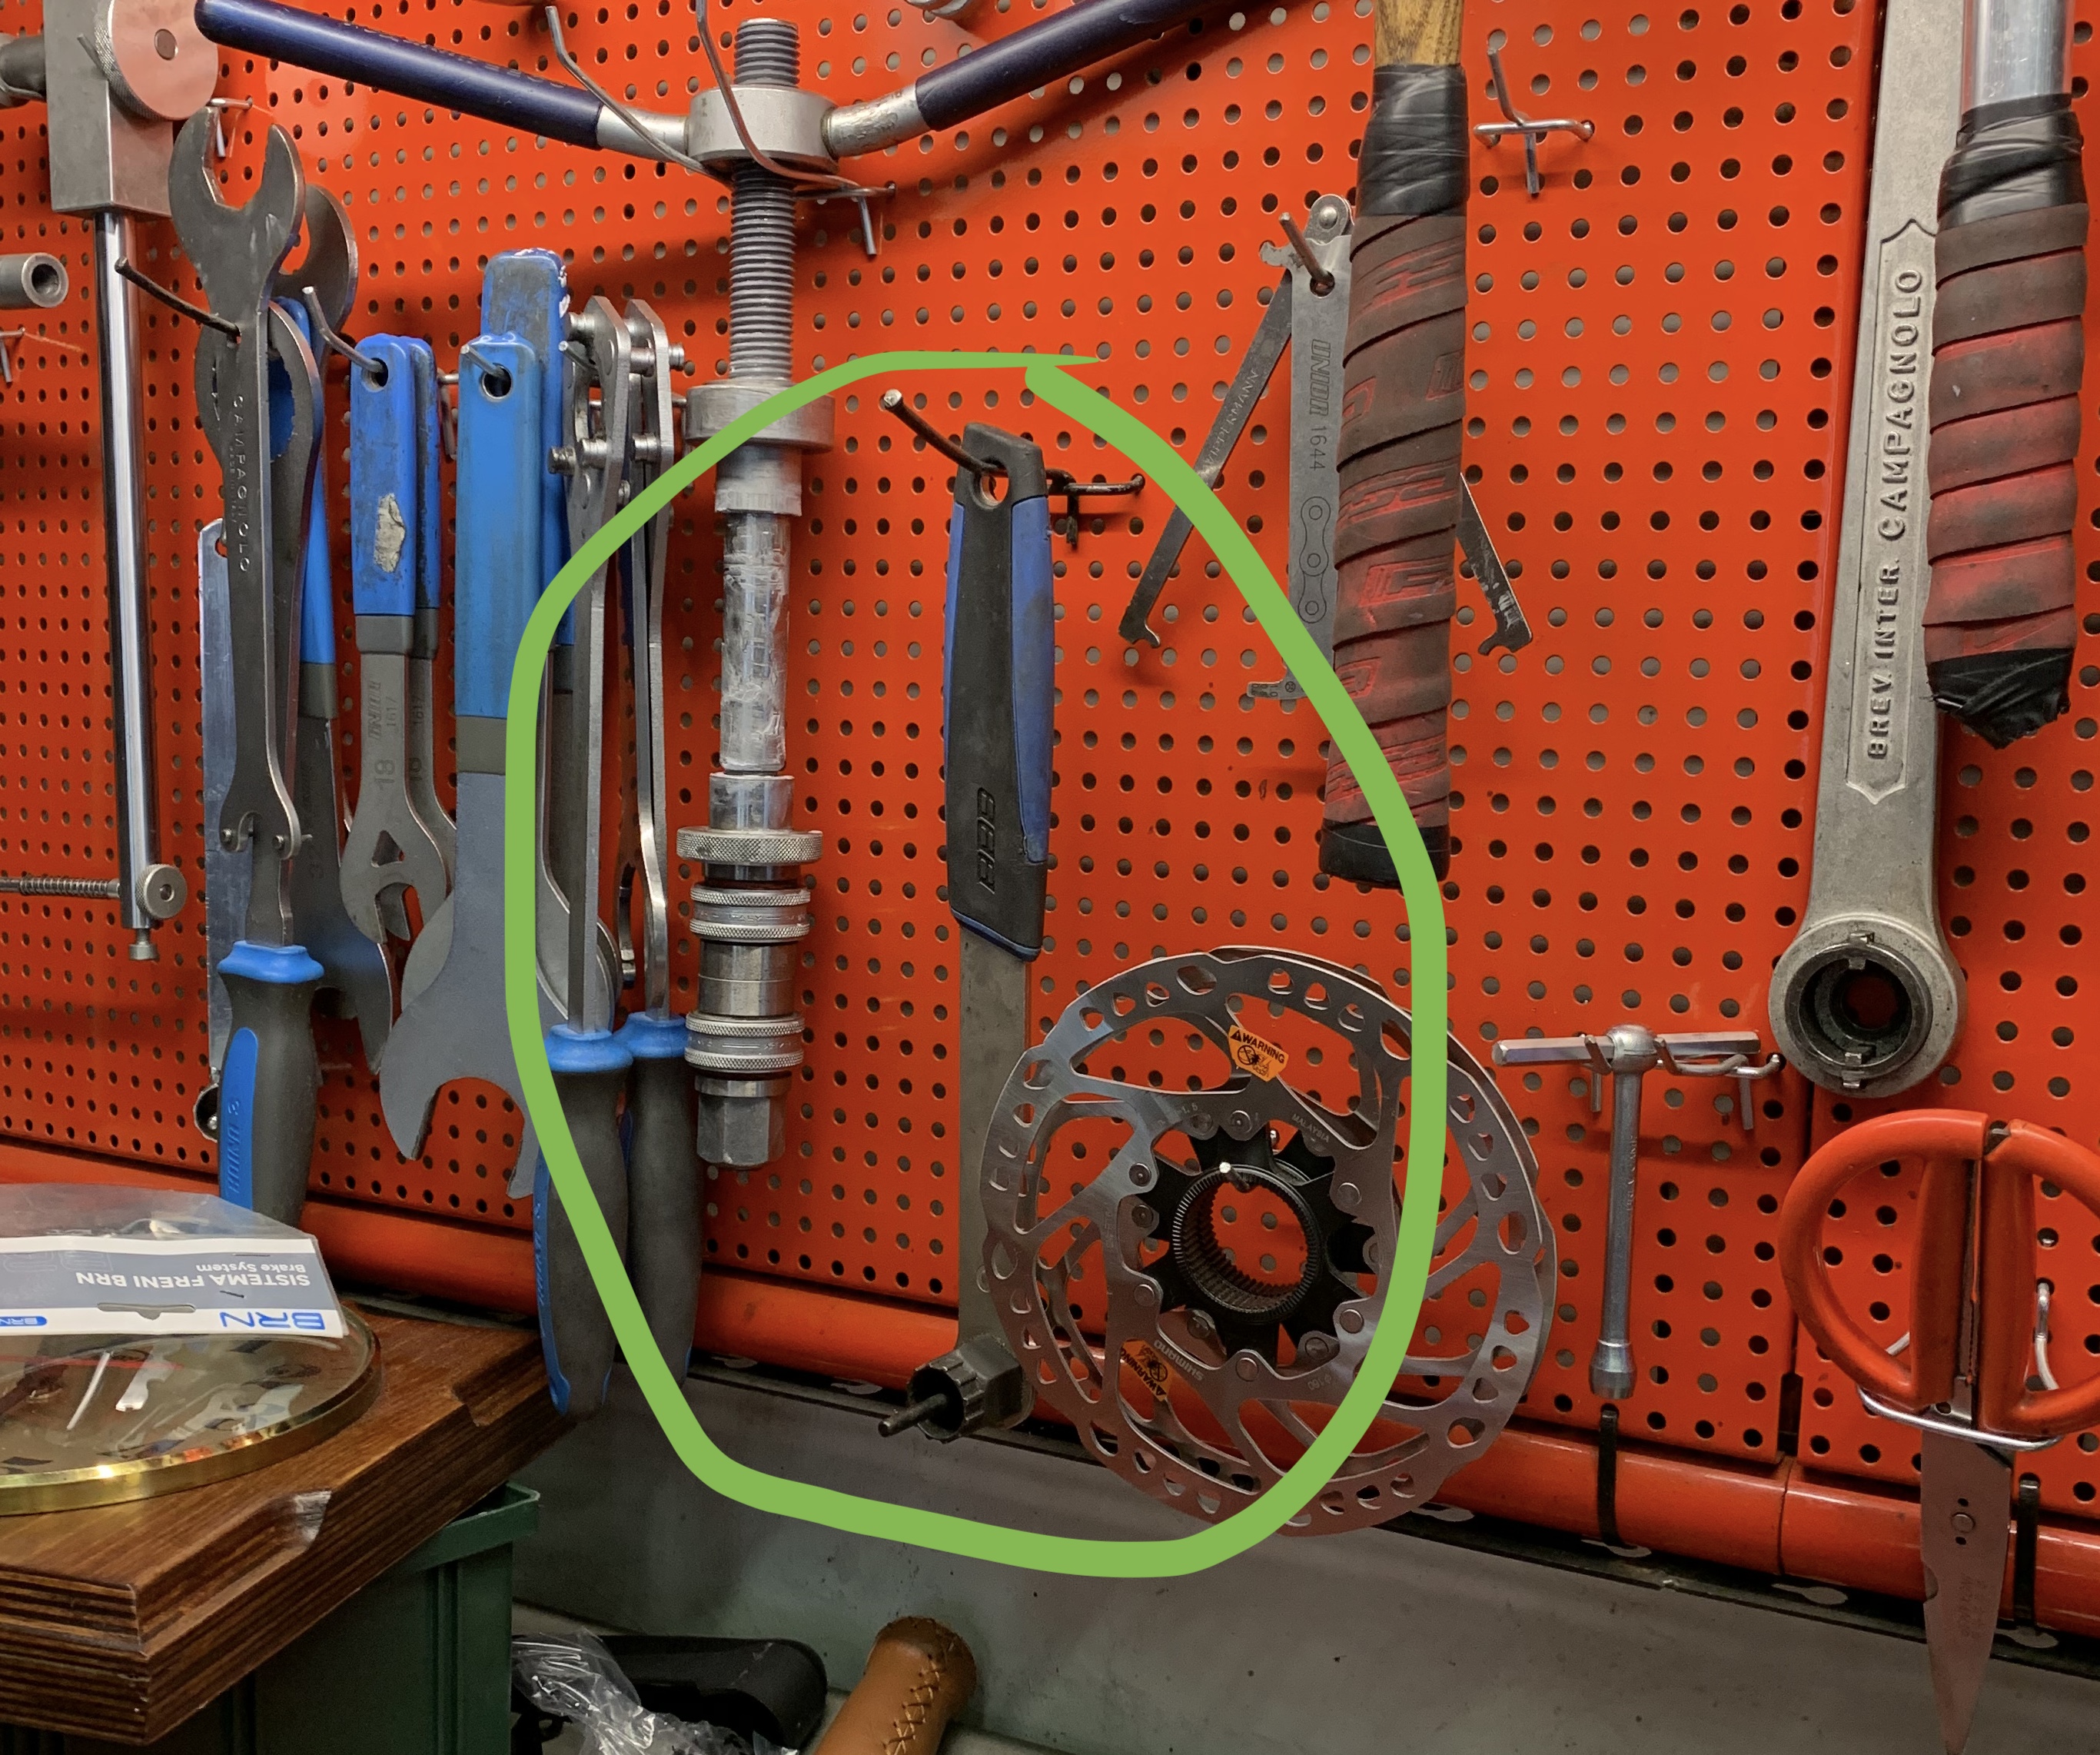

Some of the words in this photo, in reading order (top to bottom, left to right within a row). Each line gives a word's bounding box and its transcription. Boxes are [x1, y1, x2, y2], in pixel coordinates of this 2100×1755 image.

[1309, 338, 1331, 417] UNIOR
[1878, 269, 1922, 540] CAMPAGNOLO
[1309, 425, 1327, 471] 1644
[233, 394, 251, 572] CAMPAGNOLO
[1874, 558, 1899, 659] INTER.
[1867, 673, 1892, 760] BREV.
[374, 759, 396, 791] 18
[1242, 1032, 1285, 1064] WARNING
[1291, 1113, 1330, 1143] MALAYSIA
[75, 1271, 127, 1288] BRN
[132, 1273, 204, 1288] FRENI
[195, 1262, 256, 1274] System
[214, 1272, 311, 1287] SISTEMA
[261, 1263, 306, 1273] Brake
[220, 1311, 326, 1331] BRN
[1121, 1347, 1158, 1390] WARNING
[1154, 1338, 1205, 1381] SHIMANO
